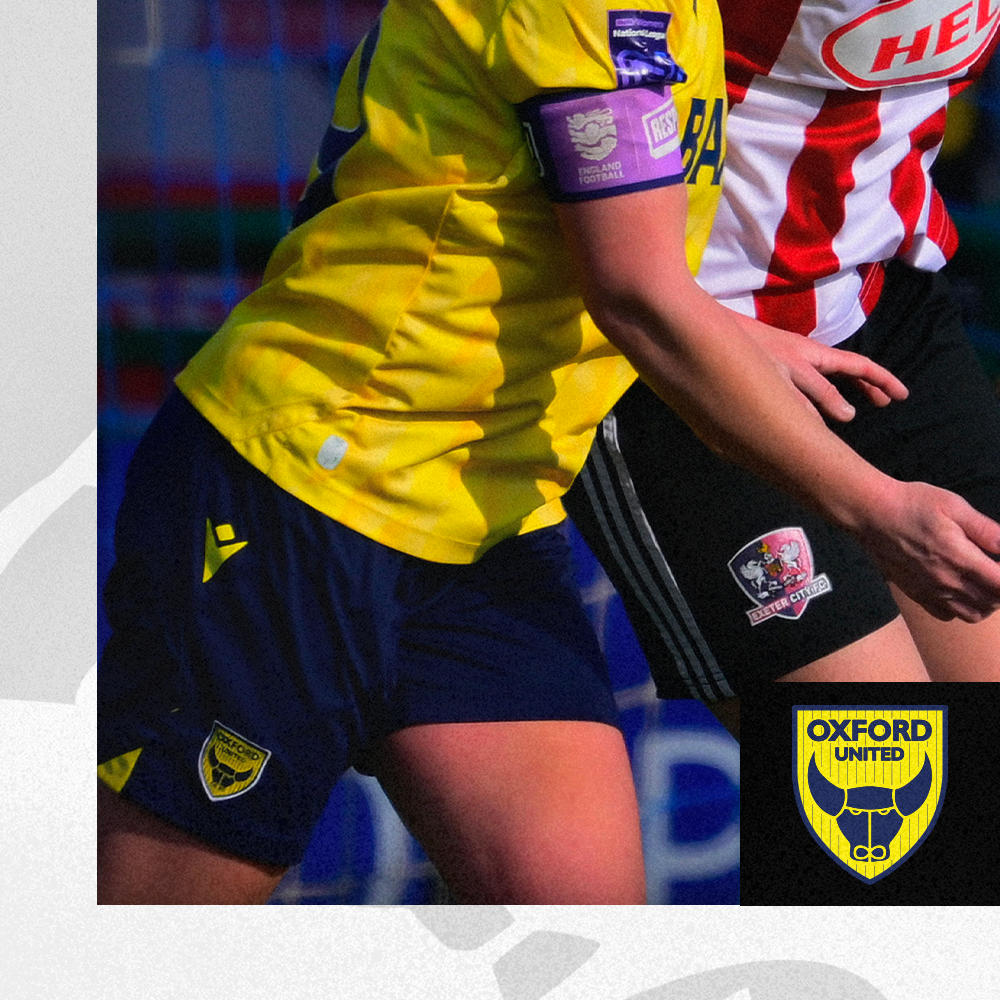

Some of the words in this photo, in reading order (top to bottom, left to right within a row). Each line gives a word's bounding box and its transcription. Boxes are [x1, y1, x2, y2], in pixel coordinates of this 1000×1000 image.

[578, 161, 622, 176] ENGLAND
[578, 170, 626, 185] FOOTBALL
[751, 597, 790, 621] EXETER
[789, 585, 812, 603] CITY
[217, 732, 260, 761] OXFORD
